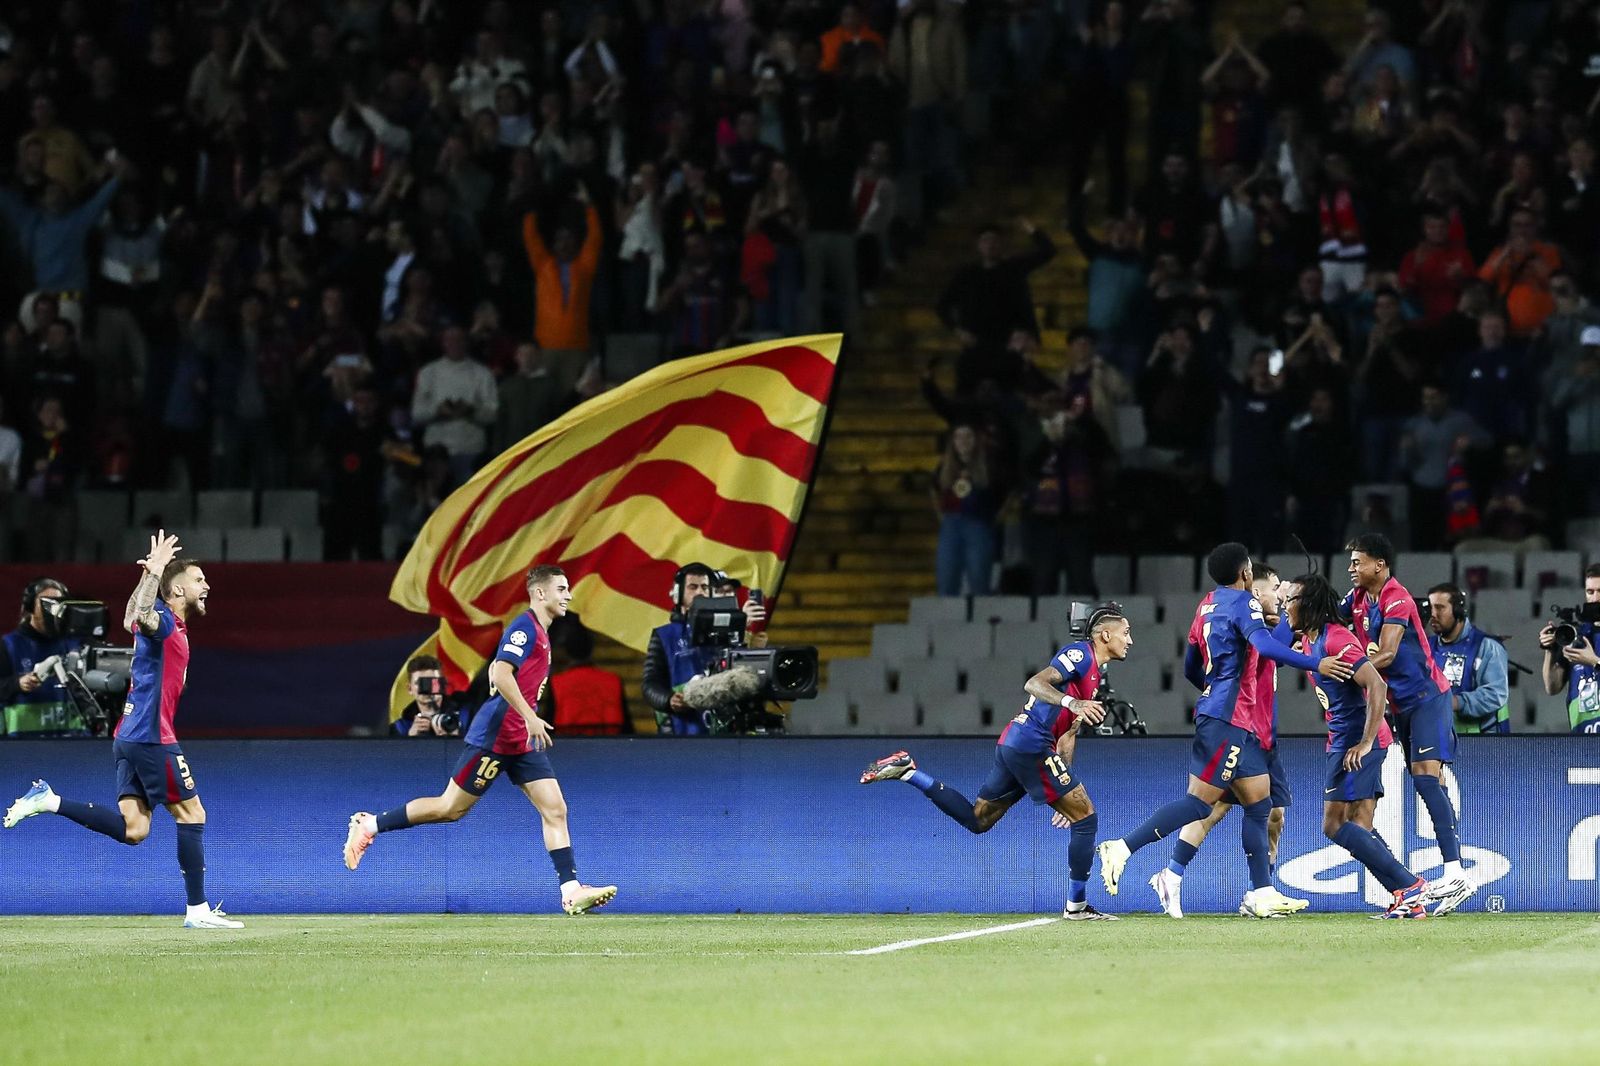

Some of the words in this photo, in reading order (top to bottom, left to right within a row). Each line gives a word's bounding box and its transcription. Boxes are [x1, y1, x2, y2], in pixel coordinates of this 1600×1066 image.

[176, 755, 191, 778] 5
[476, 756, 501, 780] 16
[1044, 755, 1067, 777] 11
[1225, 745, 1241, 769] 3
